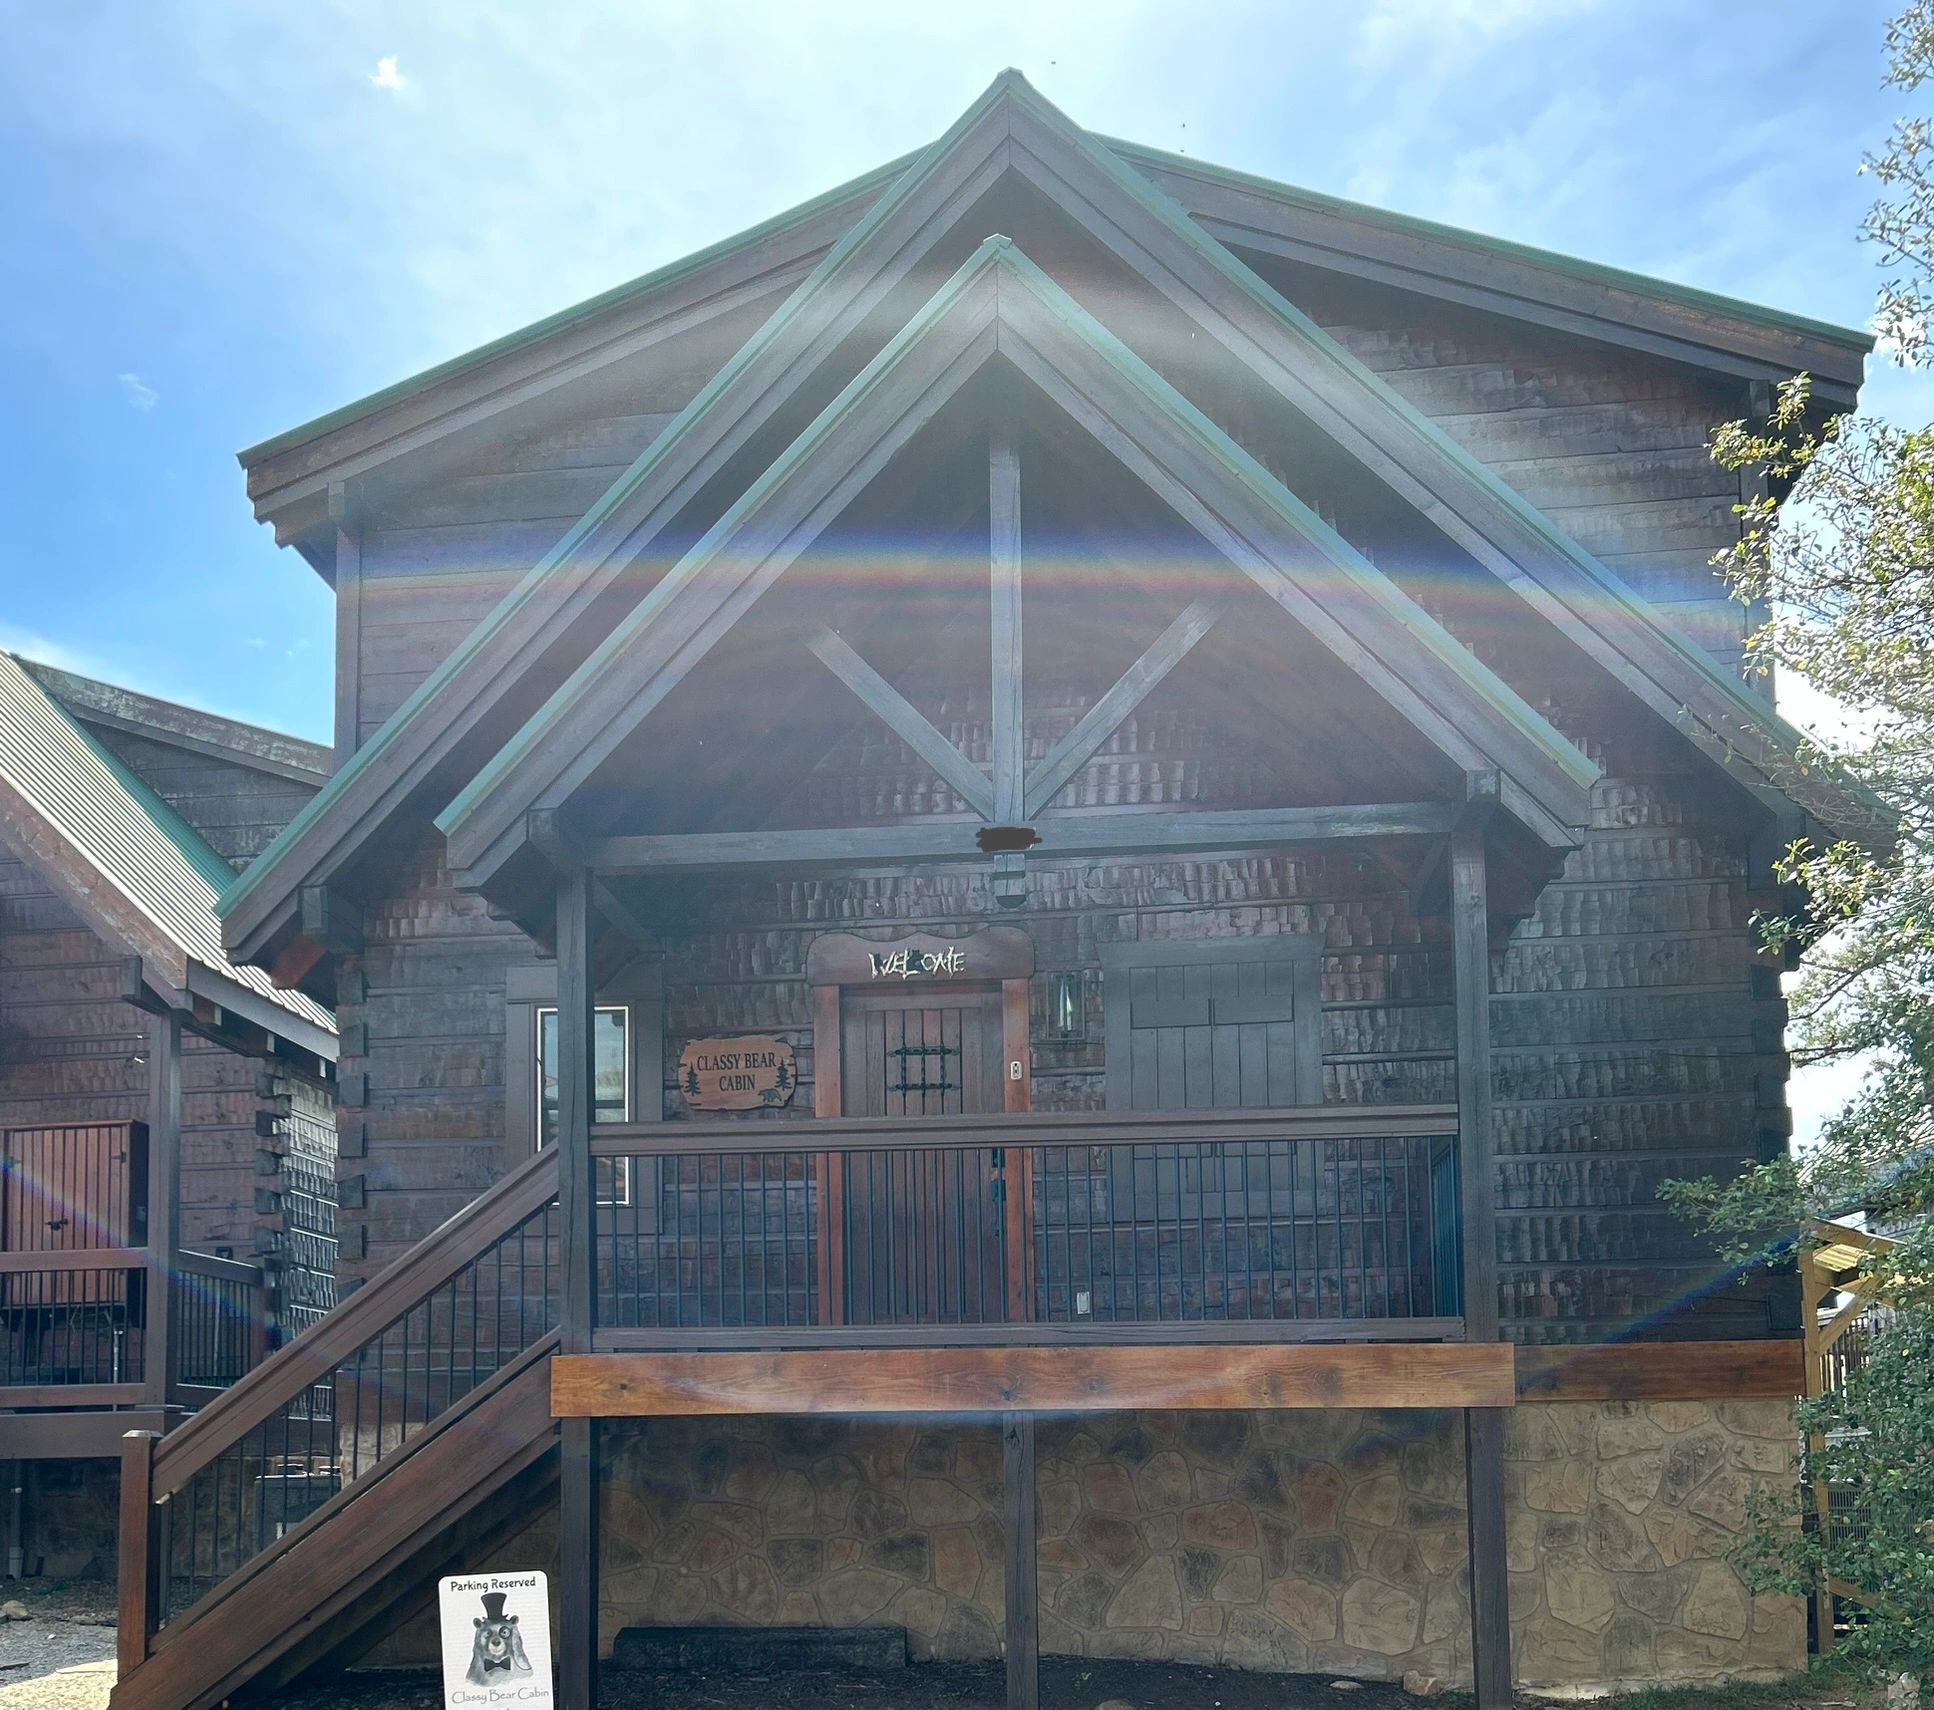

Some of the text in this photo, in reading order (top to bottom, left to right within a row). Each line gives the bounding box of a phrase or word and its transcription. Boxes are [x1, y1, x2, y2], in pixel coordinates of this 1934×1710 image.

[868, 945, 966, 980] WELOME
[697, 1052, 777, 1071] CLASSY BEAR
[719, 1074, 756, 1092] CABIN
[450, 1576, 536, 1593] Parking Reserved
[451, 1686, 549, 1704] Classy Bear Cabin
